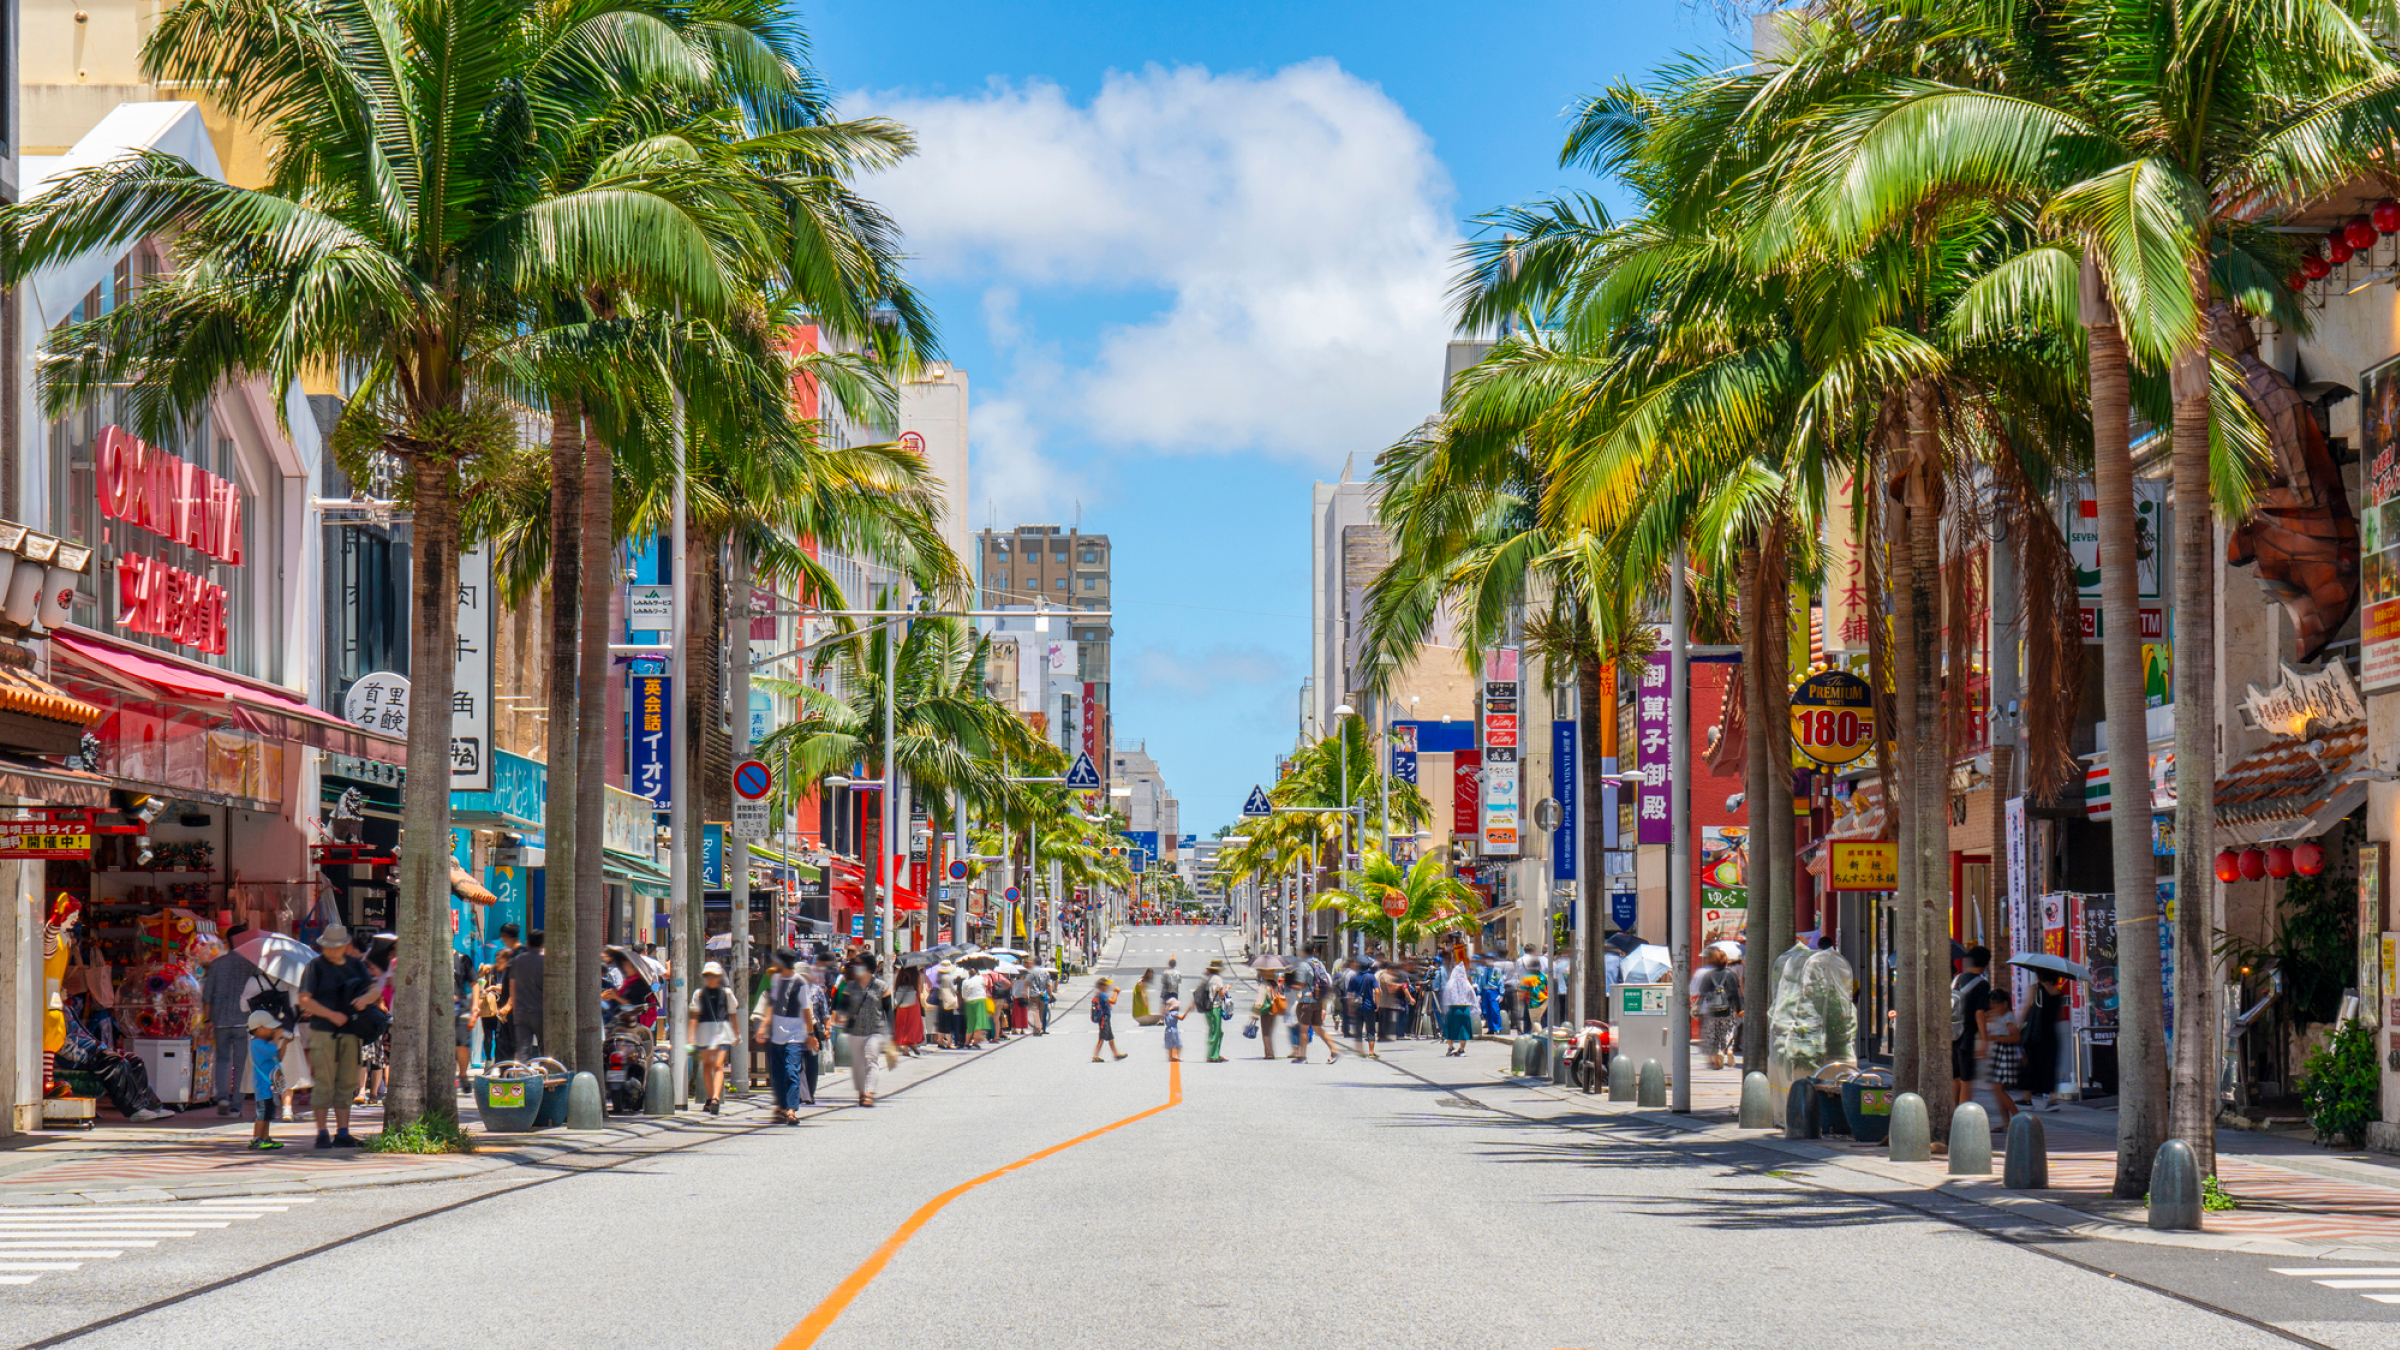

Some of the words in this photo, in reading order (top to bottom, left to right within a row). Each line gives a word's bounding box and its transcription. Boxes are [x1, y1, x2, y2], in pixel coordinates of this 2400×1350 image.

[2072, 533, 2098, 542] SEVEN
[2140, 613, 2161, 633] TM
[1809, 684, 1863, 700] PREMIUM
[1798, 709, 1874, 748] 180円
[1641, 663, 1667, 821] 御菓子御殿
[1397, 757, 1405, 779] アニ
